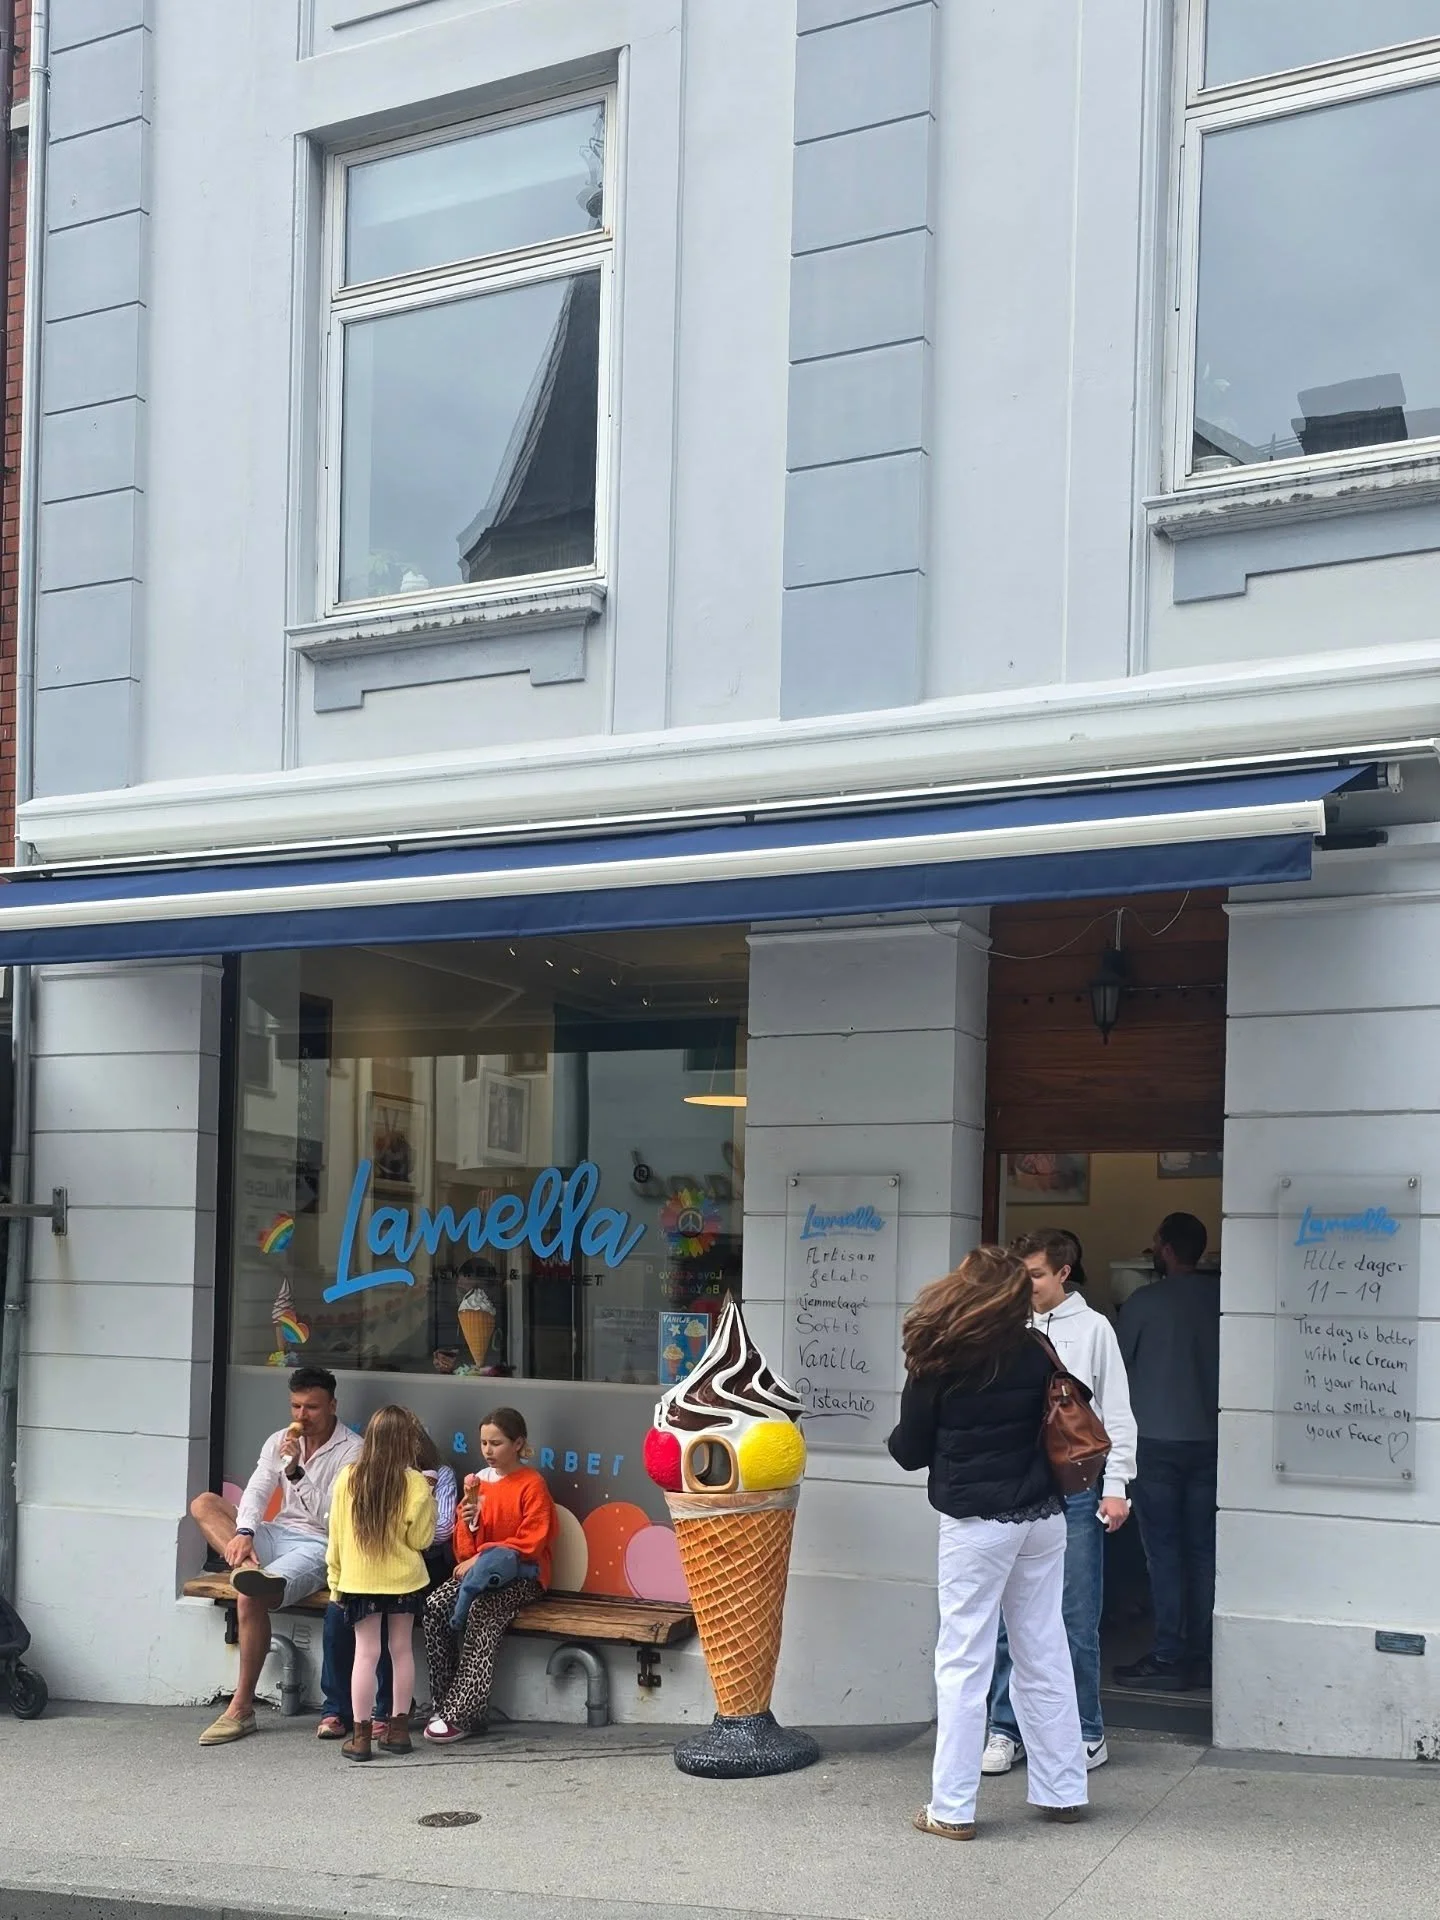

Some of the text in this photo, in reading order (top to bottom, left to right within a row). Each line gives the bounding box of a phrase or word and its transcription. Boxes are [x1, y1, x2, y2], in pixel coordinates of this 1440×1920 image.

[323, 1159, 645, 1303] Lamella
[800, 1203, 886, 1240] Lamella
[1295, 1205, 1400, 1246] Lamella
[806, 1246, 875, 1265] Artisan
[1354, 1253, 1408, 1277] dager
[1293, 1313, 1321, 1334] The
[1326, 1322, 1353, 1343] day
[1358, 1326, 1369, 1340] is
[799, 1339, 870, 1374] Vanilla
[795, 1377, 875, 1413] Pistachio
[1304, 1368, 1397, 1396] in your hand
[1293, 1400, 1320, 1414] and
[1325, 1403, 1336, 1415] a
[1393, 1409, 1410, 1423] on
[453, 1431, 468, 1454] &
[1306, 1423, 1342, 1442] your
